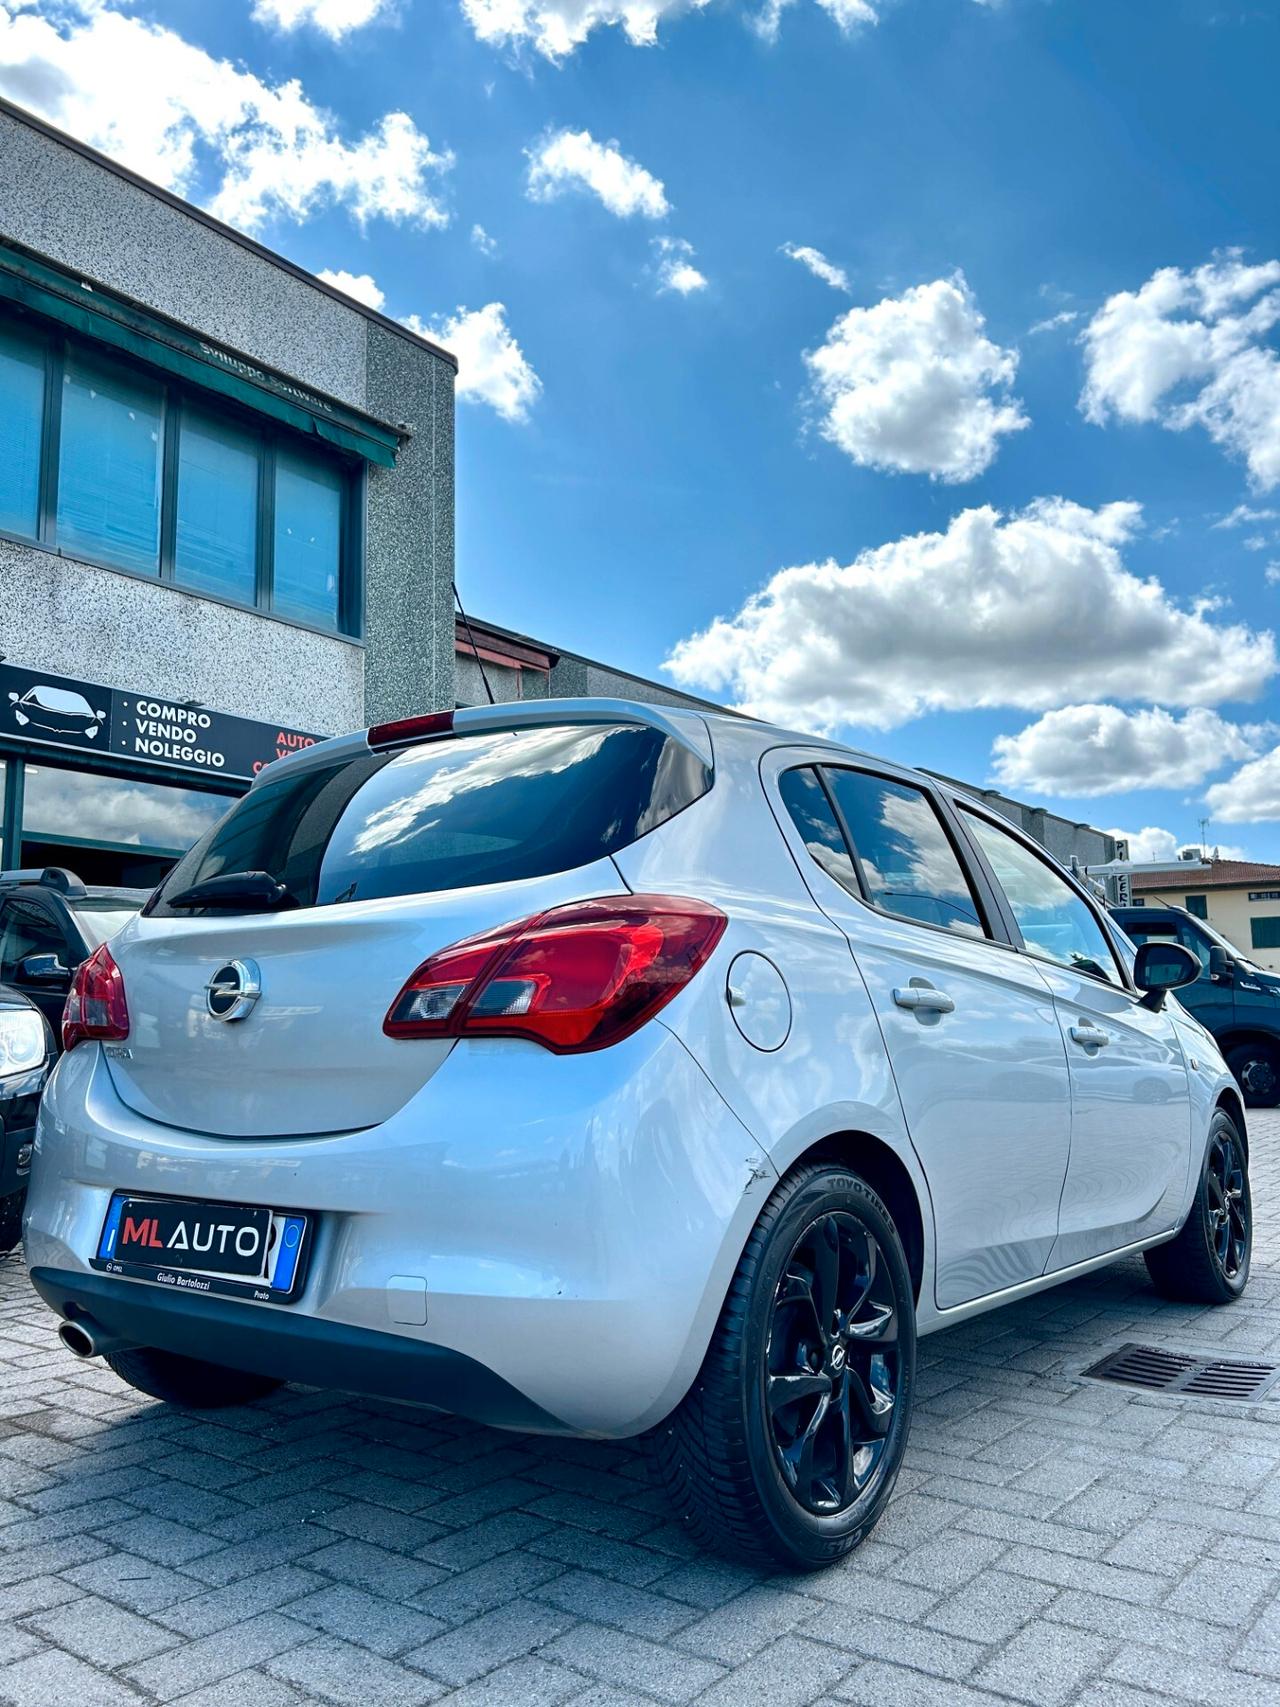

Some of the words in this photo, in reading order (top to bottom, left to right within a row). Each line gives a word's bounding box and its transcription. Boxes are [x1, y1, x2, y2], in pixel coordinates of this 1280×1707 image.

[136, 700, 211, 728] COMPRO
[135, 718, 197, 743] VENDO
[135, 741, 225, 767] NOLEGGIO
[122, 1216, 163, 1248] ML
[167, 1220, 260, 1257] AUTO
[156, 1272, 176, 1285] Giulio
[176, 1276, 211, 1290] Bartolozzi
[253, 1290, 270, 1300] Prato
